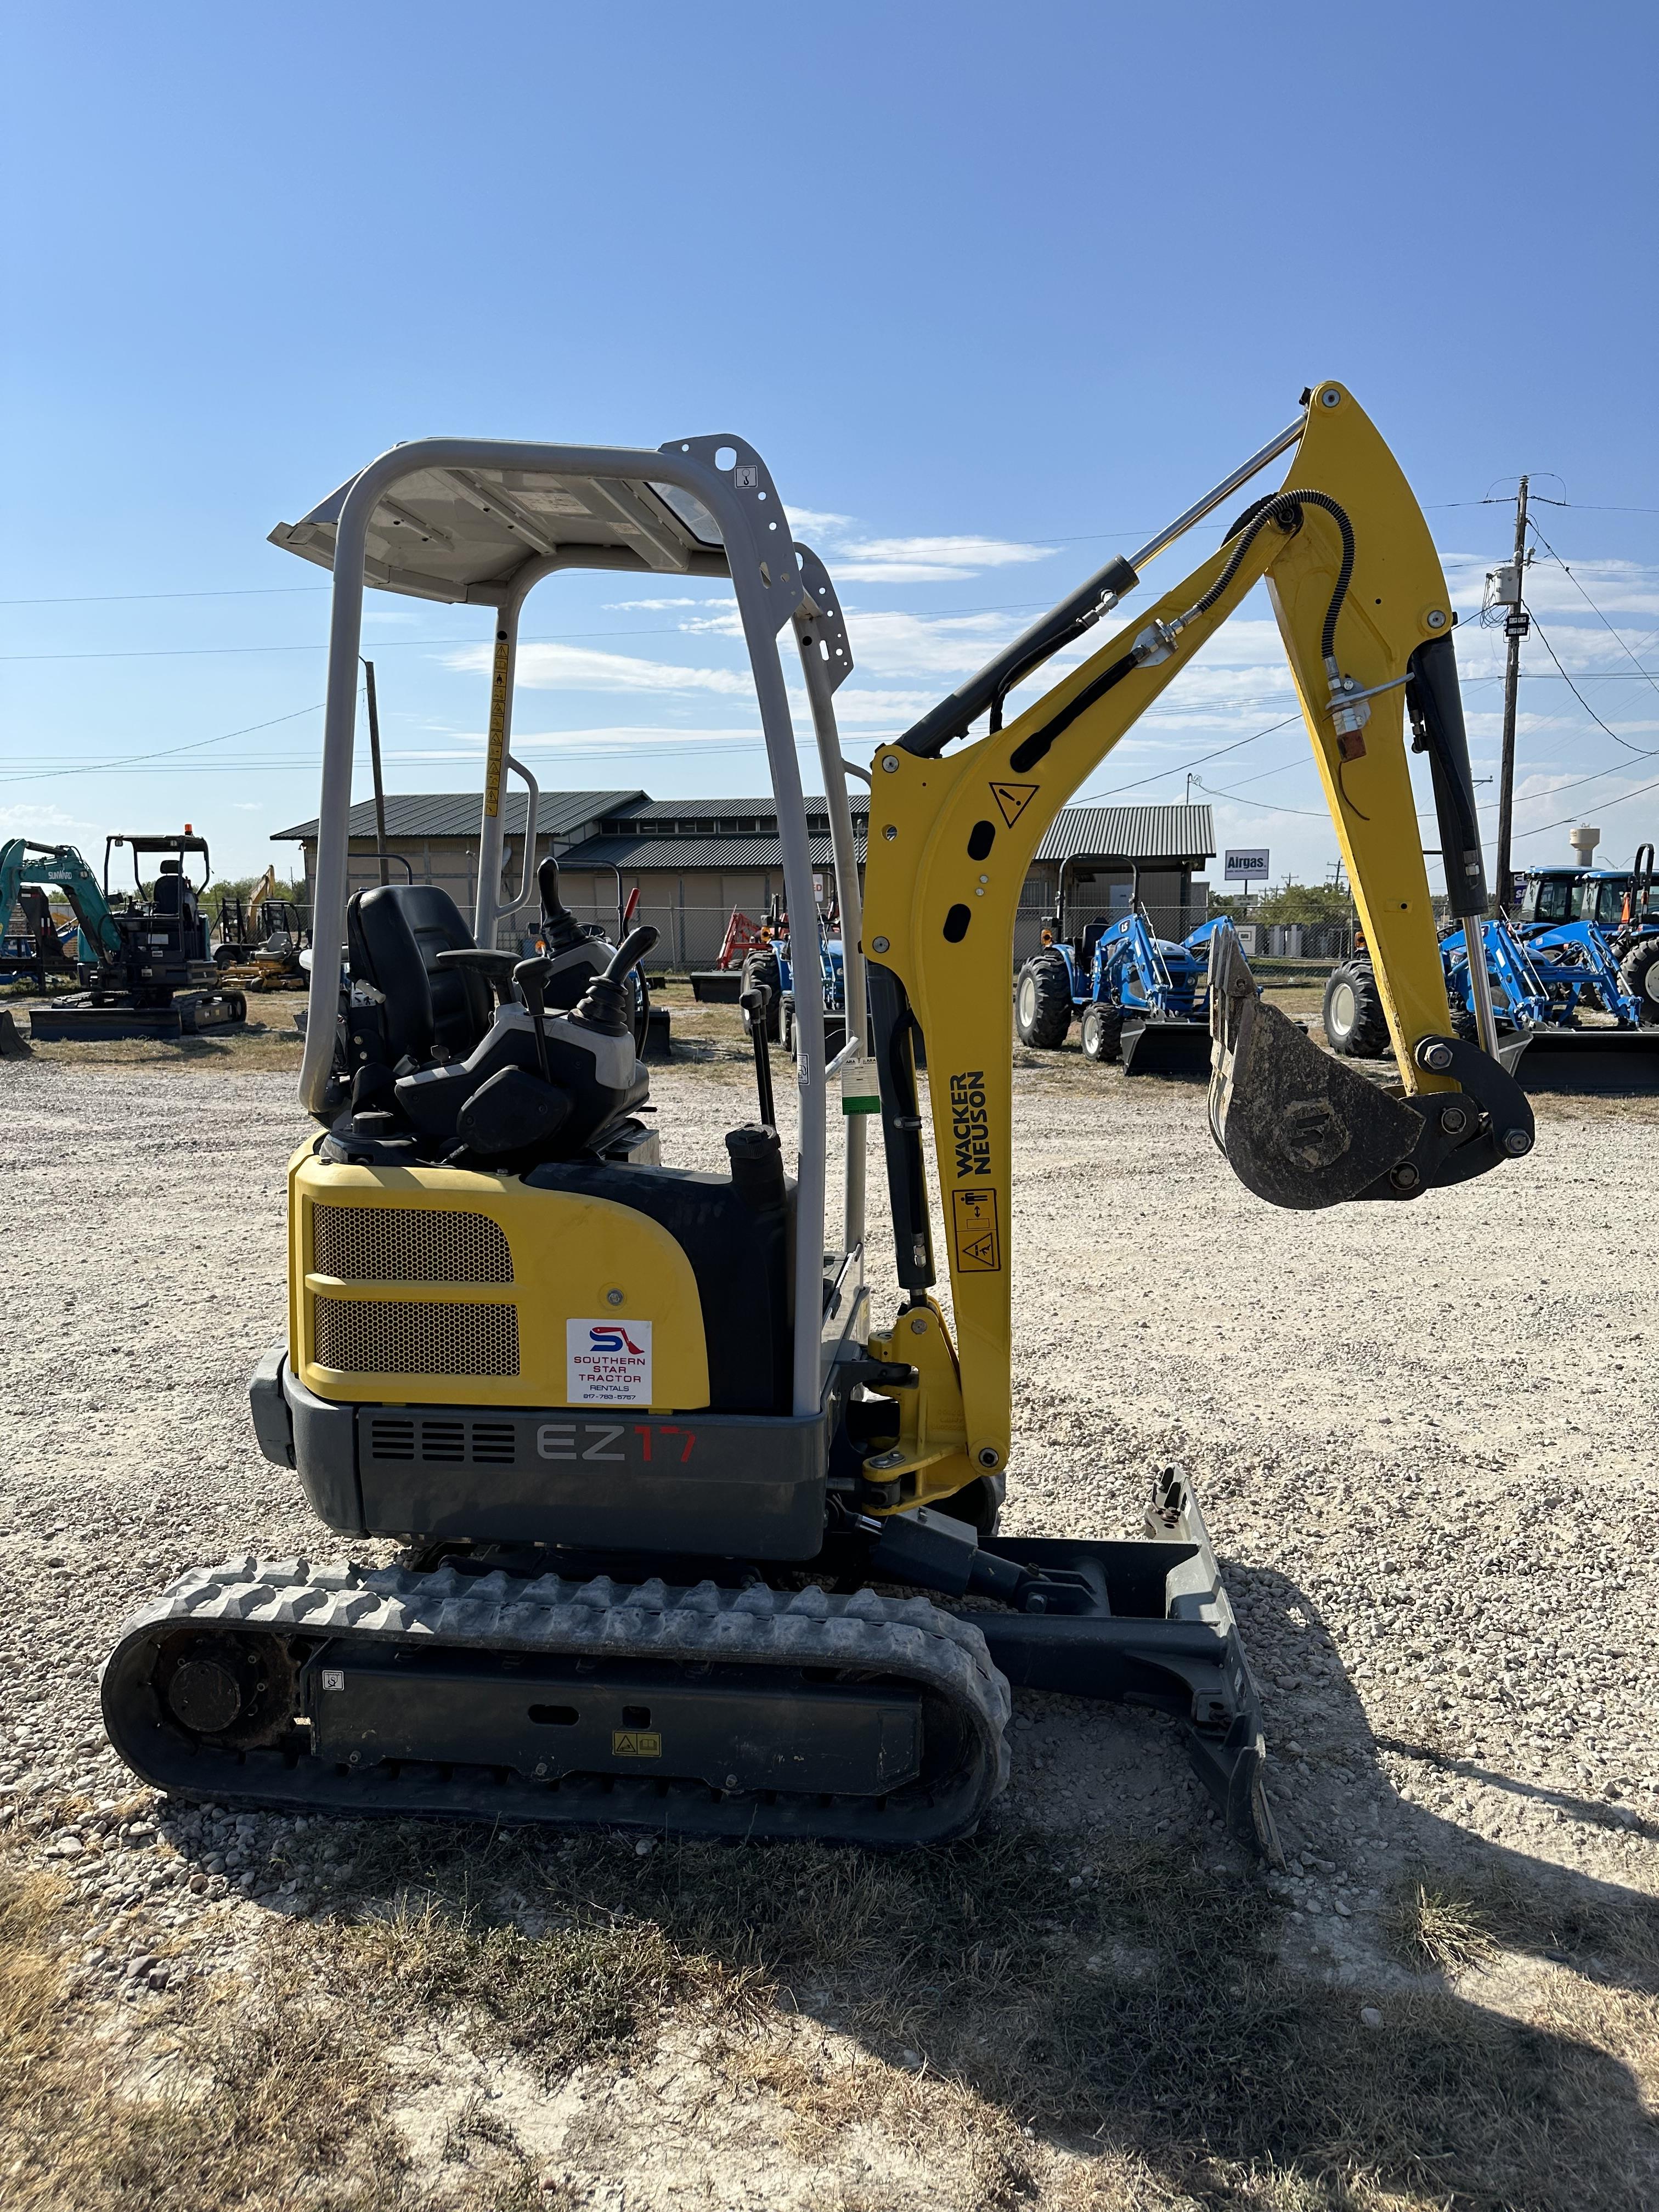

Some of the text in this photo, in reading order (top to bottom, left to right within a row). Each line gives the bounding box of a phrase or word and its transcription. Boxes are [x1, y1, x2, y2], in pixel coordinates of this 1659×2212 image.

[1227, 856, 1263, 868] Airgas
[48, 870, 72, 879] SUNWARD
[950, 1072, 973, 1178] WACKER
[967, 1071, 991, 1175] NEUSON
[574, 1356, 645, 1365] SOUTHERN
[579, 1374, 641, 1383] TRACTOR
[537, 1424, 696, 1462] EZ17
